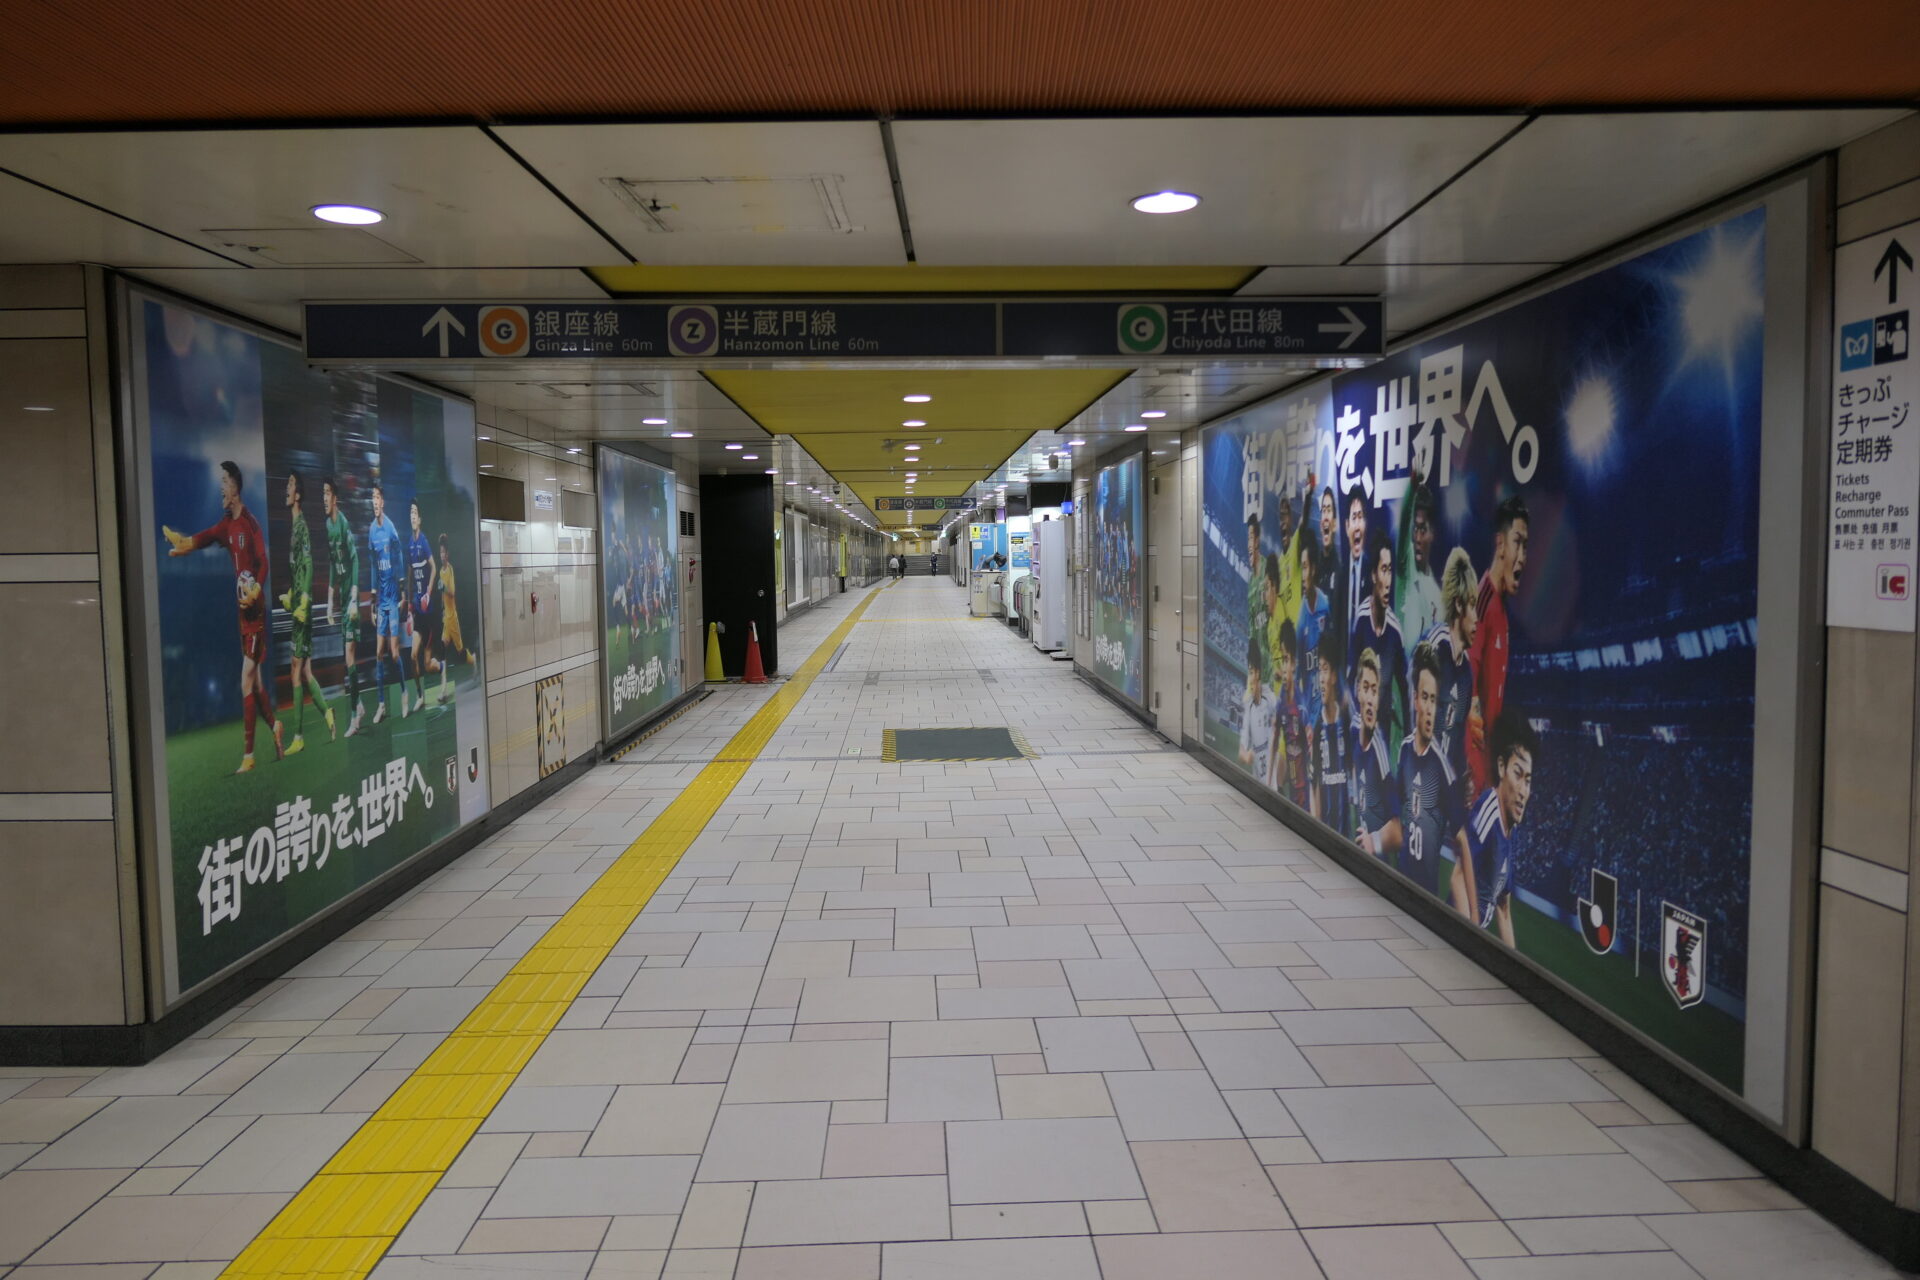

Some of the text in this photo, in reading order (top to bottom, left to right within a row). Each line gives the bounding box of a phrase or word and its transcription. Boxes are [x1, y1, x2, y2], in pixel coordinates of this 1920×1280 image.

[534, 310, 620, 336] 銀座線
[724, 310, 837, 336] 半蔵門線
[1135, 322, 1148, 338] C
[1172, 308, 1283, 335] 千代田線
[496, 323, 511, 340] G
[687, 323, 701, 340] Z
[535, 339, 653, 352] Ginza Line 60m
[724, 339, 880, 352] Hanzomon Line 60m
[1172, 335, 1305, 352] Chiyoda Line 80m
[1838, 375, 1892, 408] きっぷ
[1837, 402, 1910, 437] チャージ
[1836, 436, 1894, 466] 定期券
[1835, 473, 1870, 487] Tickets
[1835, 488, 1882, 505] Recharge
[1835, 504, 1910, 519] Commuter Pass
[197, 756, 434, 936] 街の誇りを、世界へ。
[1408, 821, 1423, 860] 20
[1671, 909, 1696, 928] JAPAN
